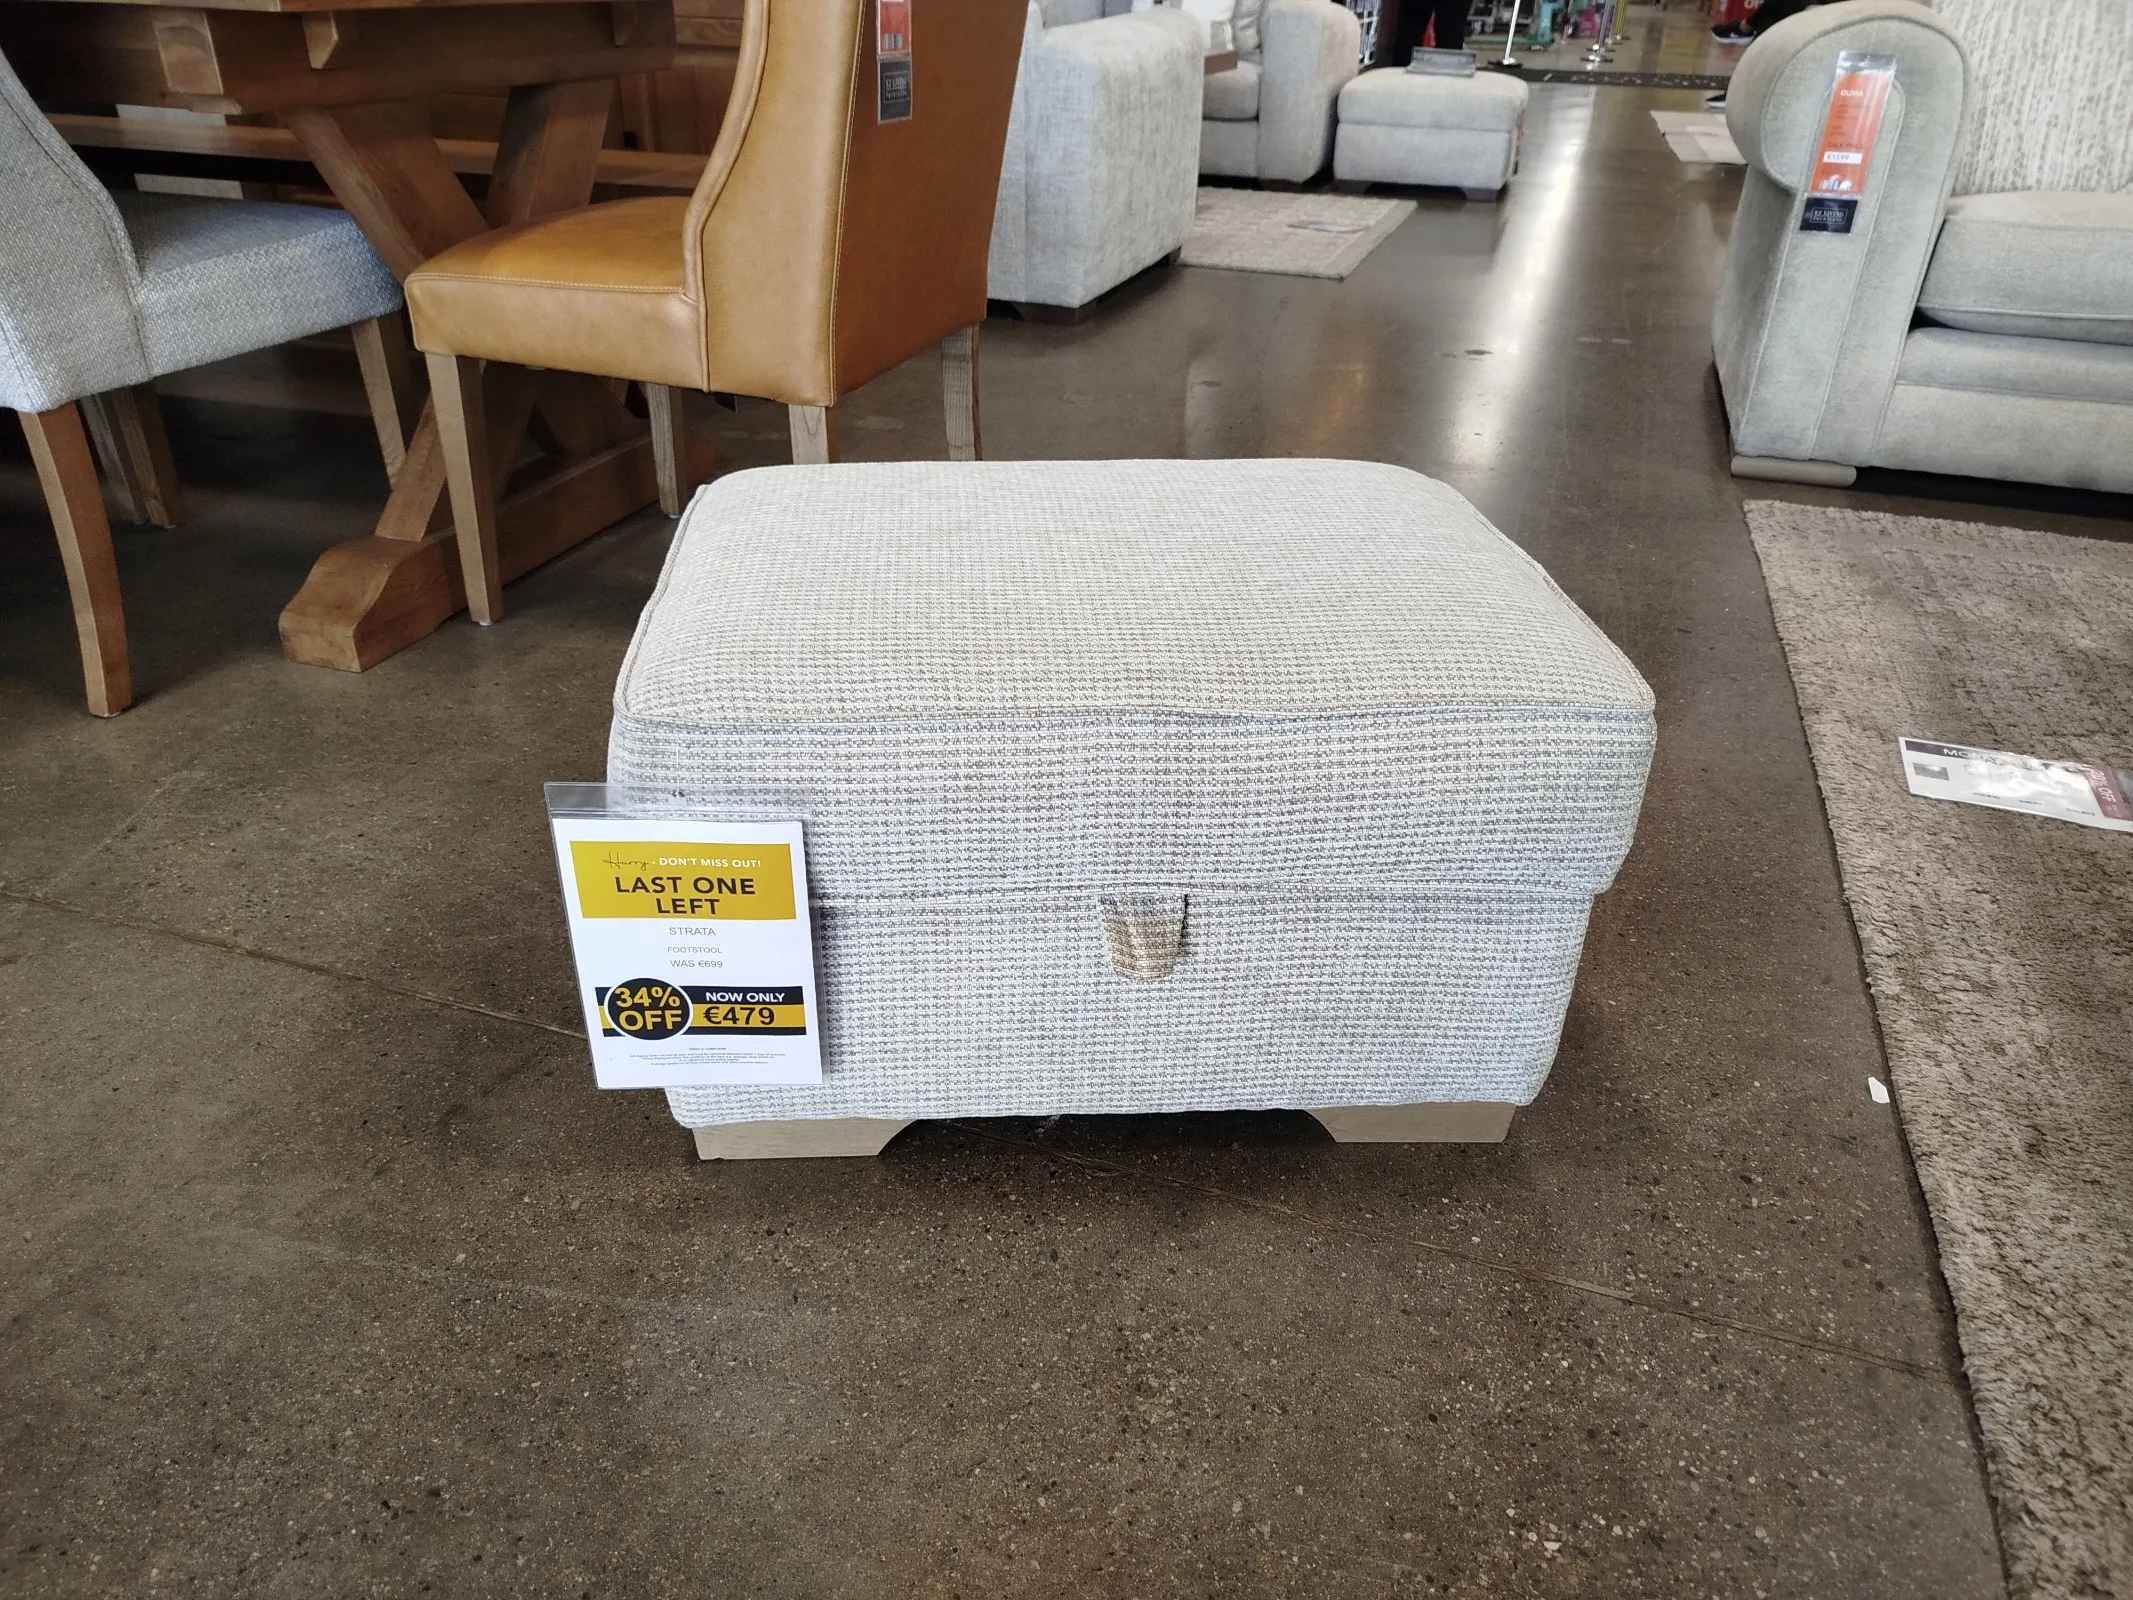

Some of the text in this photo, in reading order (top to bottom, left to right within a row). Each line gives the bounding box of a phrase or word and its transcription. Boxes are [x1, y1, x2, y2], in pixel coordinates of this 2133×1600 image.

[1840, 89, 1864, 97] OLIVIA
[602, 852, 649, 872] Hurry
[659, 857, 698, 867] DON'T
[700, 858, 729, 868] MISS
[731, 859, 762, 869] OUT!
[615, 876, 756, 895] LAST ONE
[656, 898, 720, 916] LEFT
[668, 926, 717, 937] STRATA
[667, 946, 723, 954] FOOTSTOOL
[669, 959, 723, 969] WAS €699
[615, 986, 681, 1008] 34%
[705, 991, 786, 1003] NOW ONLY
[619, 1010, 682, 1031] OFF
[703, 1005, 775, 1026] €479
